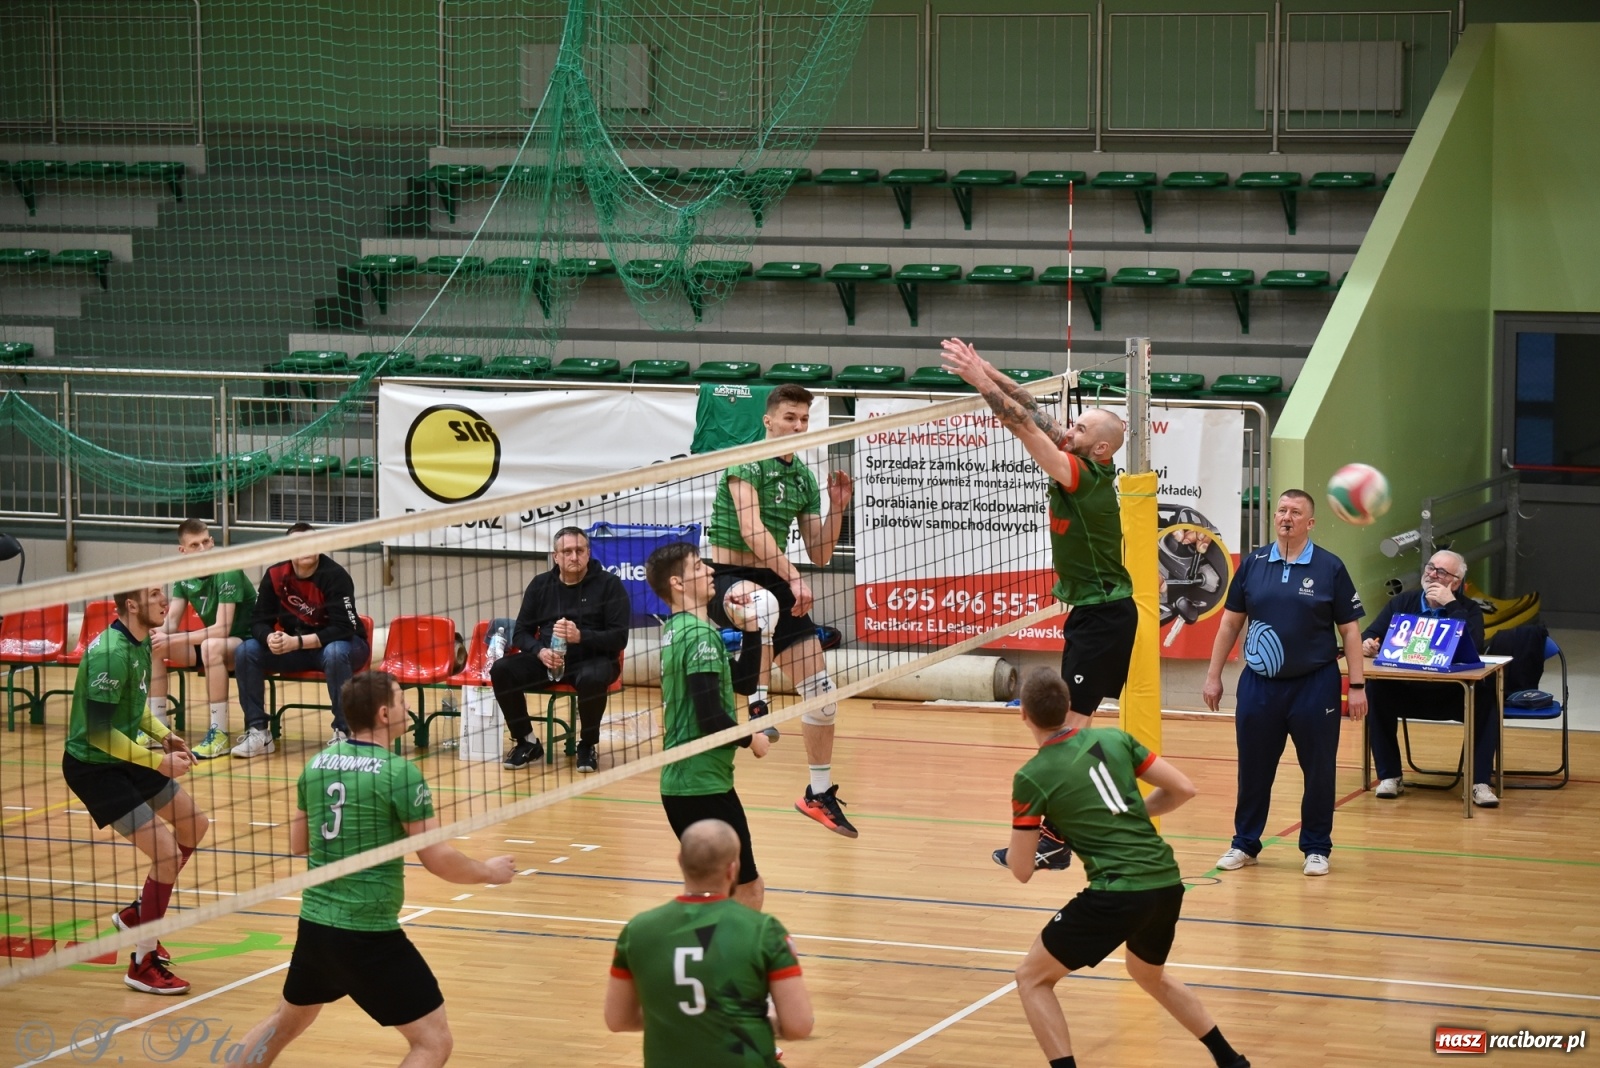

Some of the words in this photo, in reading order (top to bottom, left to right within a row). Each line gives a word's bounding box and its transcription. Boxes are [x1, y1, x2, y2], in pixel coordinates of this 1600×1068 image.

[911, 430, 988, 448] MIESZKAŃ
[866, 456, 926, 470] Sprzedaż
[865, 473, 923, 488] (oferujemy
[926, 475, 971, 488] również
[974, 476, 1015, 489] montaż
[866, 495, 938, 510] Dorabianie
[941, 500, 969, 512] oraz
[972, 498, 1047, 514] kodowanie
[872, 515, 922, 530] pilotów
[925, 518, 1038, 535] samochodowych
[602, 562, 646, 581] olte
[887, 587, 935, 611] 695
[941, 589, 986, 615] 496
[991, 592, 1040, 617] 555
[864, 617, 923, 632] Racibórz
[1395, 620, 1411, 643] 8
[1427, 623, 1434, 637] 1
[1435, 623, 1451, 646] 7
[312, 753, 387, 774] WŁODOWICE
[1089, 761, 1129, 816] 11
[321, 781, 346, 840] 3
[673, 946, 707, 1016] 5
